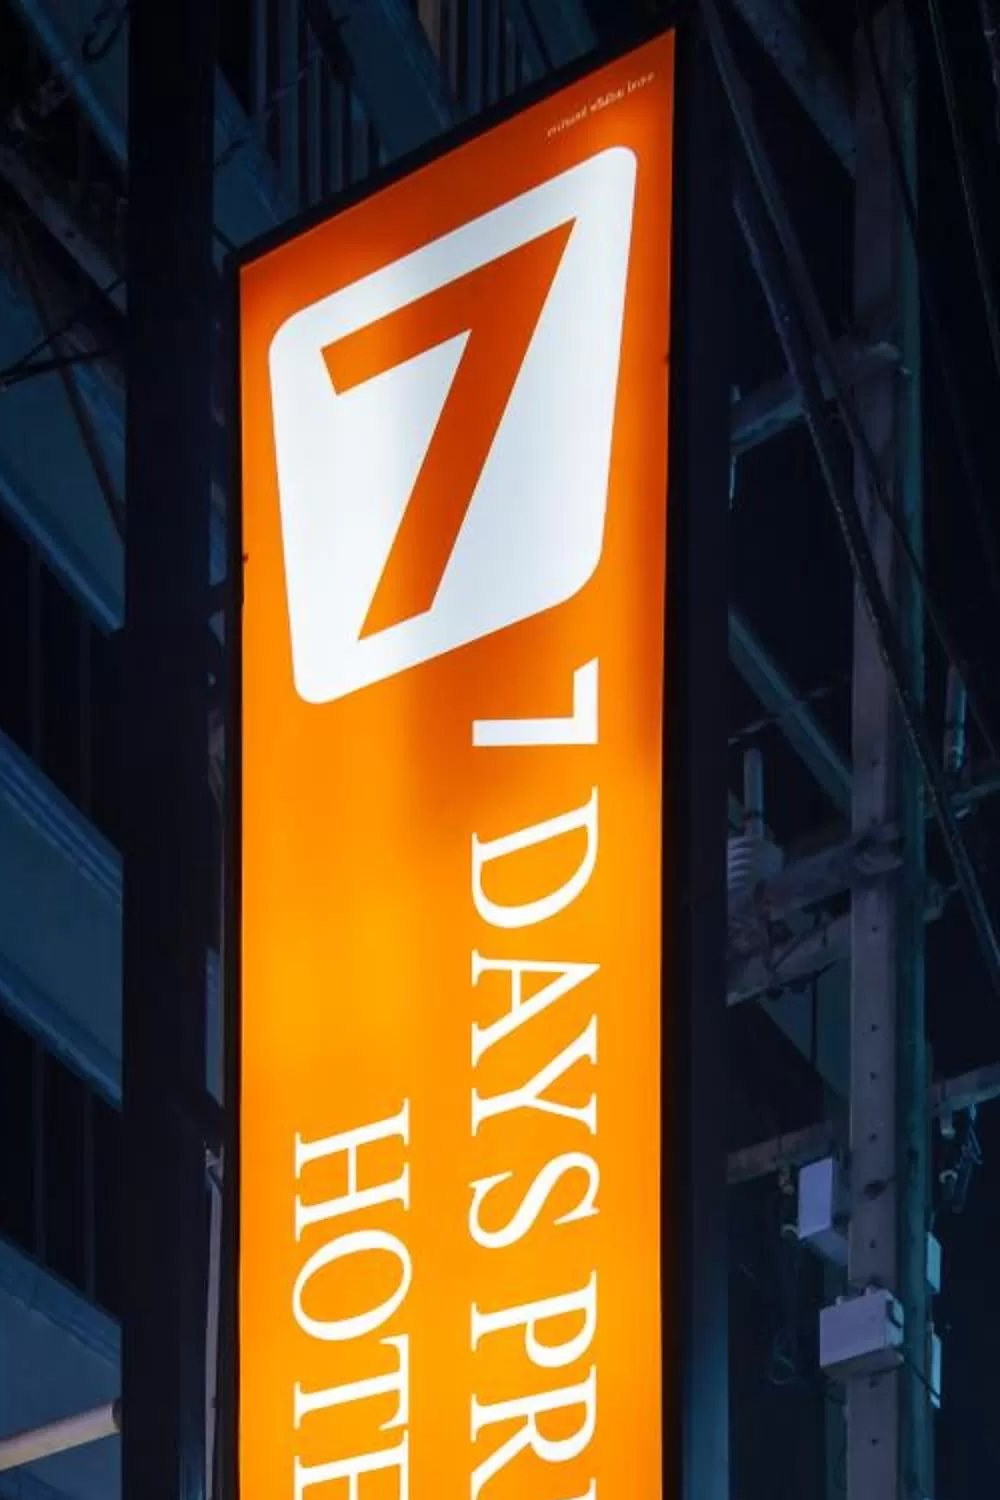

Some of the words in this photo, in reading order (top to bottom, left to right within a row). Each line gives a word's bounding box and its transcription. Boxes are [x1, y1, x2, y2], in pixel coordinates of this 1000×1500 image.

[320, 216, 578, 643] 7
[472, 657, 599, 747] 7
[469, 788, 600, 1249] DAYS
